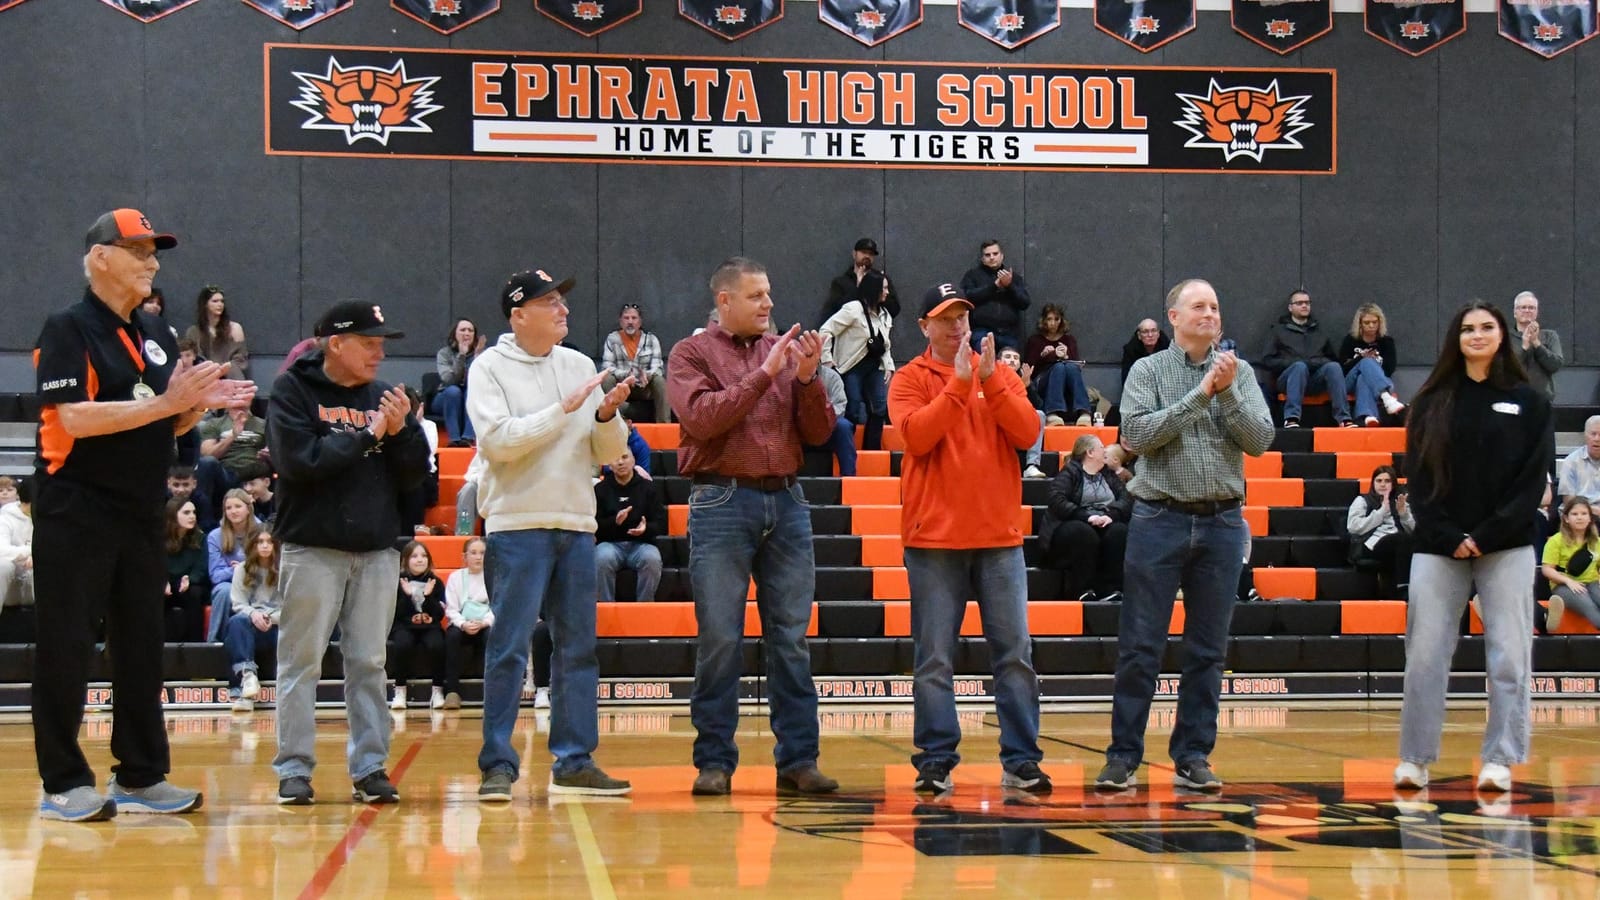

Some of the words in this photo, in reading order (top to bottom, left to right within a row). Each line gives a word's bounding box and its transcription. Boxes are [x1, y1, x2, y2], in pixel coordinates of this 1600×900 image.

[472, 61, 761, 122] EPHRATA
[783, 70, 915, 126] HIGH
[937, 73, 1148, 130] SCHOOL
[613, 126, 714, 153] HOME
[737, 130, 777, 154] OF
[801, 131, 866, 157] THE
[890, 133, 1020, 160] TIGERS
[938, 283, 957, 298] E
[42, 380, 60, 391] CLASS
[60, 378, 68, 388] OF
[614, 682, 673, 699] SCHOOL
[890, 680, 914, 696] HIG
[953, 680, 986, 696] HOOL
[1233, 678, 1288, 694] SCHOOL
[1560, 677, 1595, 693] HIGH
[174, 686, 214, 704] HIGH
